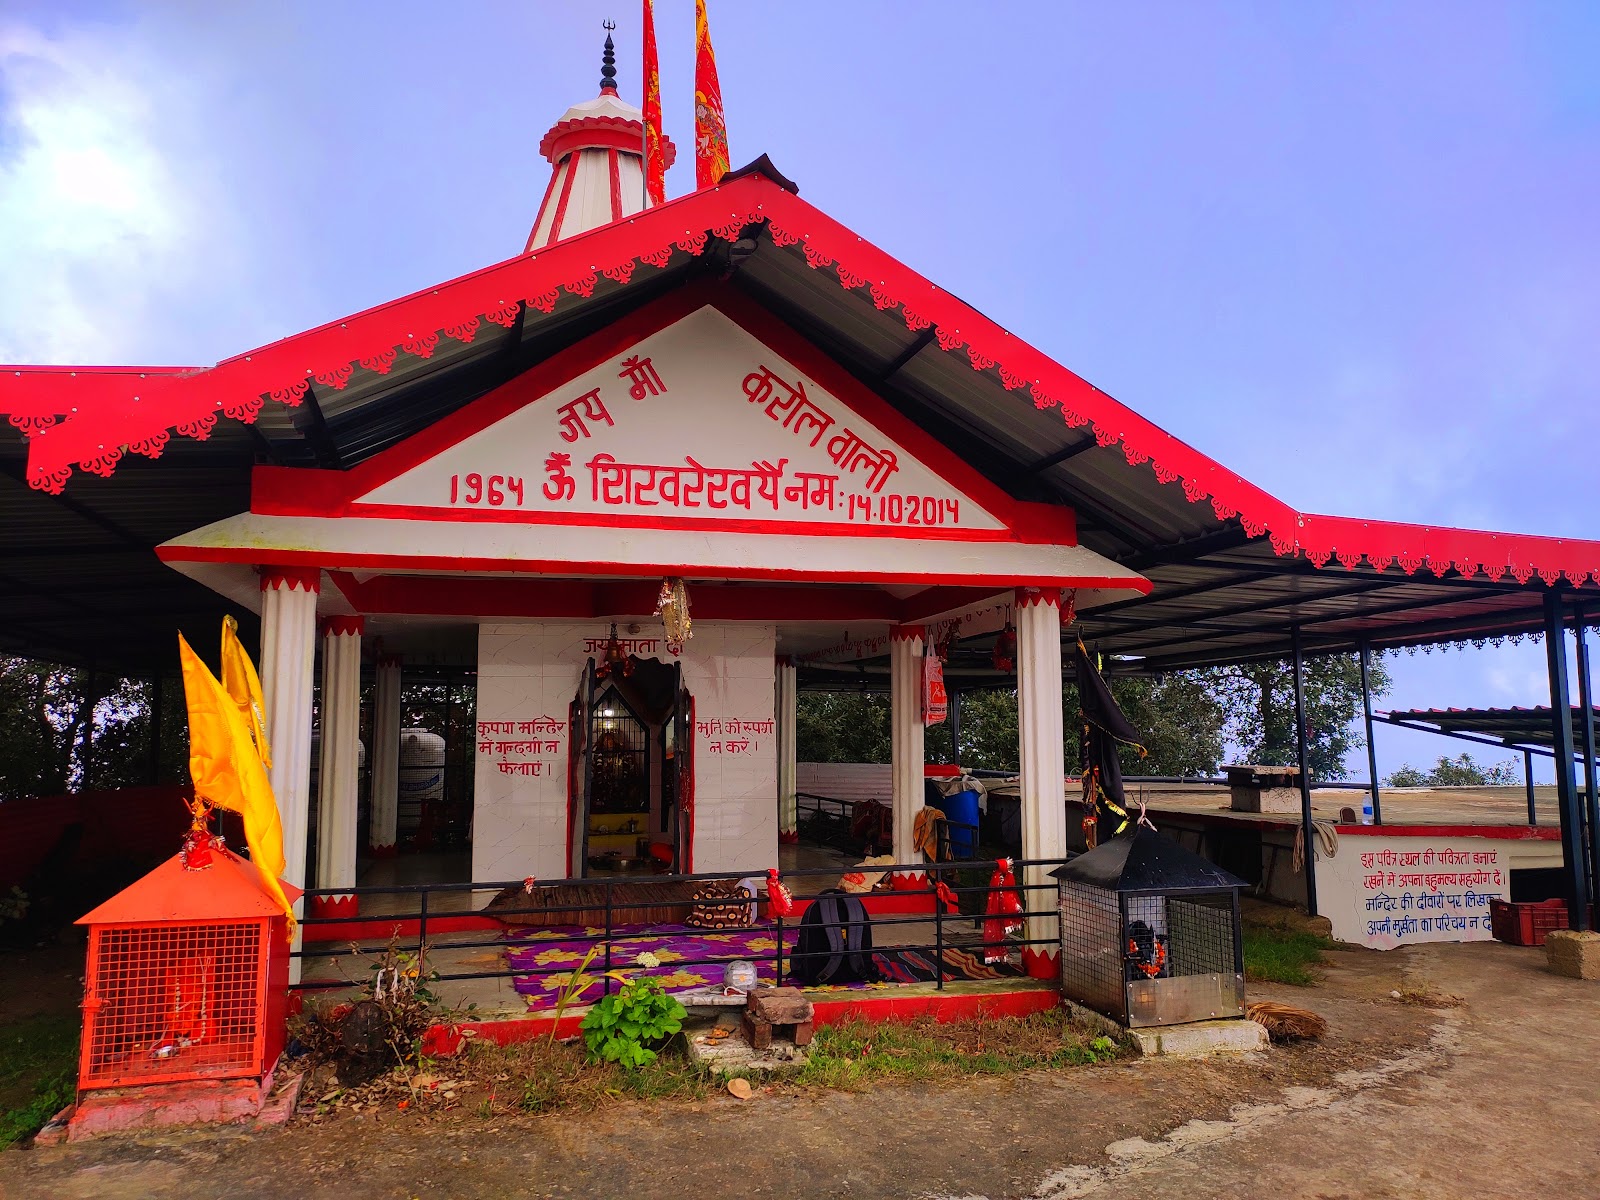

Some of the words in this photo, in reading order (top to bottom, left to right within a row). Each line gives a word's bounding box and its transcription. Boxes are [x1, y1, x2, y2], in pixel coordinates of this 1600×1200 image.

[556, 387, 615, 443] जय
[742, 364, 836, 447] करोल
[827, 427, 899, 493] वाली
[450, 472, 524, 506] 1964
[725, 718, 741, 734] को
[544, 741, 560, 753] न
[1360, 852, 1374, 868] इस
[1376, 849, 1397, 866] पवित्र
[1399, 852, 1421, 866] स्थल
[1422, 848, 1436, 865] की
[1437, 848, 1470, 865] पवित्रता
[1386, 871, 1396, 888] में
[1399, 873, 1424, 888] अपना
[1459, 869, 1491, 888] सहयोग
[1365, 892, 1398, 912] मन्दिर
[1399, 891, 1414, 910] की
[1416, 891, 1445, 910] दीवारों
[1446, 894, 1462, 909] पर
[1367, 916, 1391, 935] अपनी
[1419, 917, 1432, 932] का
[1434, 913, 1467, 931] परिचय
[1468, 916, 1480, 930] न
